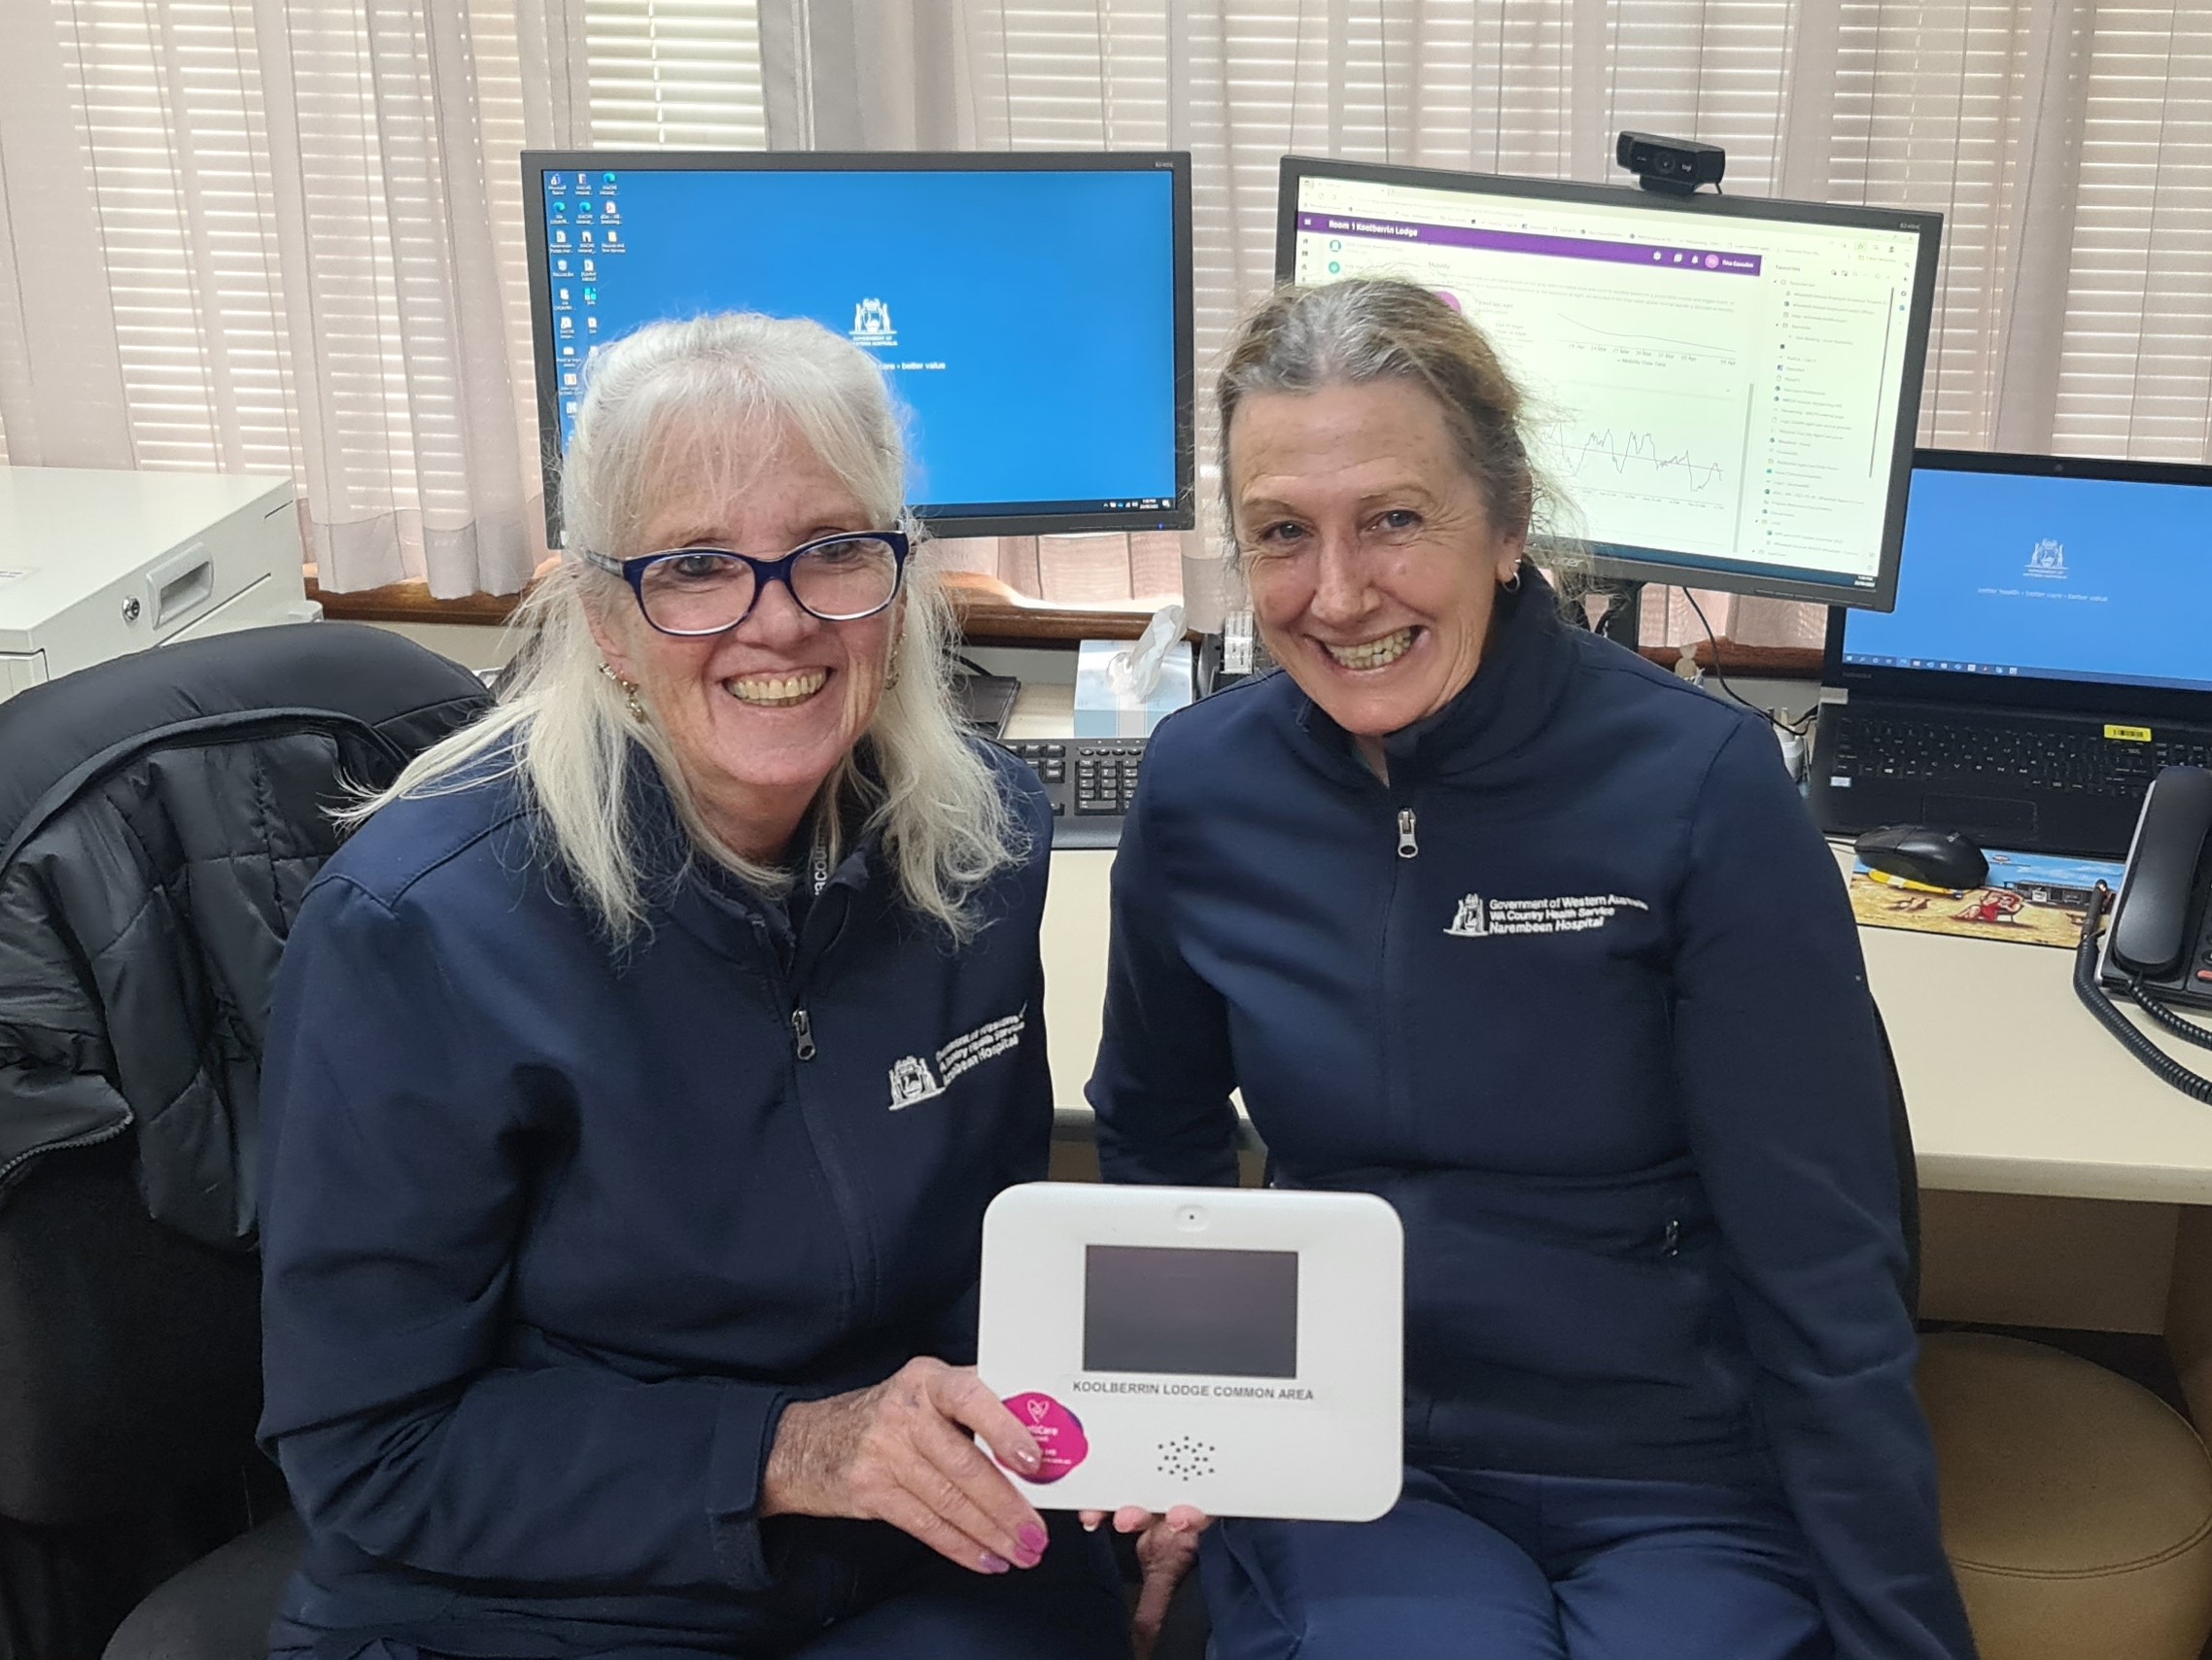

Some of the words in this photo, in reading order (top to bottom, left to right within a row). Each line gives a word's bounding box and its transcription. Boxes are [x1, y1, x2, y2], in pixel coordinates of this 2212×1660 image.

[1489, 898, 1548, 911] Government
[1548, 898, 1561, 909] of
[1561, 896, 1607, 909] Western
[1489, 910, 1506, 921] WA
[1506, 910, 1544, 922] Country
[1545, 908, 1576, 920] Health
[1577, 906, 1615, 917] Service
[1489, 920, 1553, 934] Narembeen
[1555, 916, 1605, 932] Hospital
[1072, 1381, 1159, 1395] KOOLBERRIN
[1162, 1384, 1210, 1397] LODGE
[1213, 1386, 1275, 1400] COMMON
[1277, 1388, 1315, 1401] AREA
